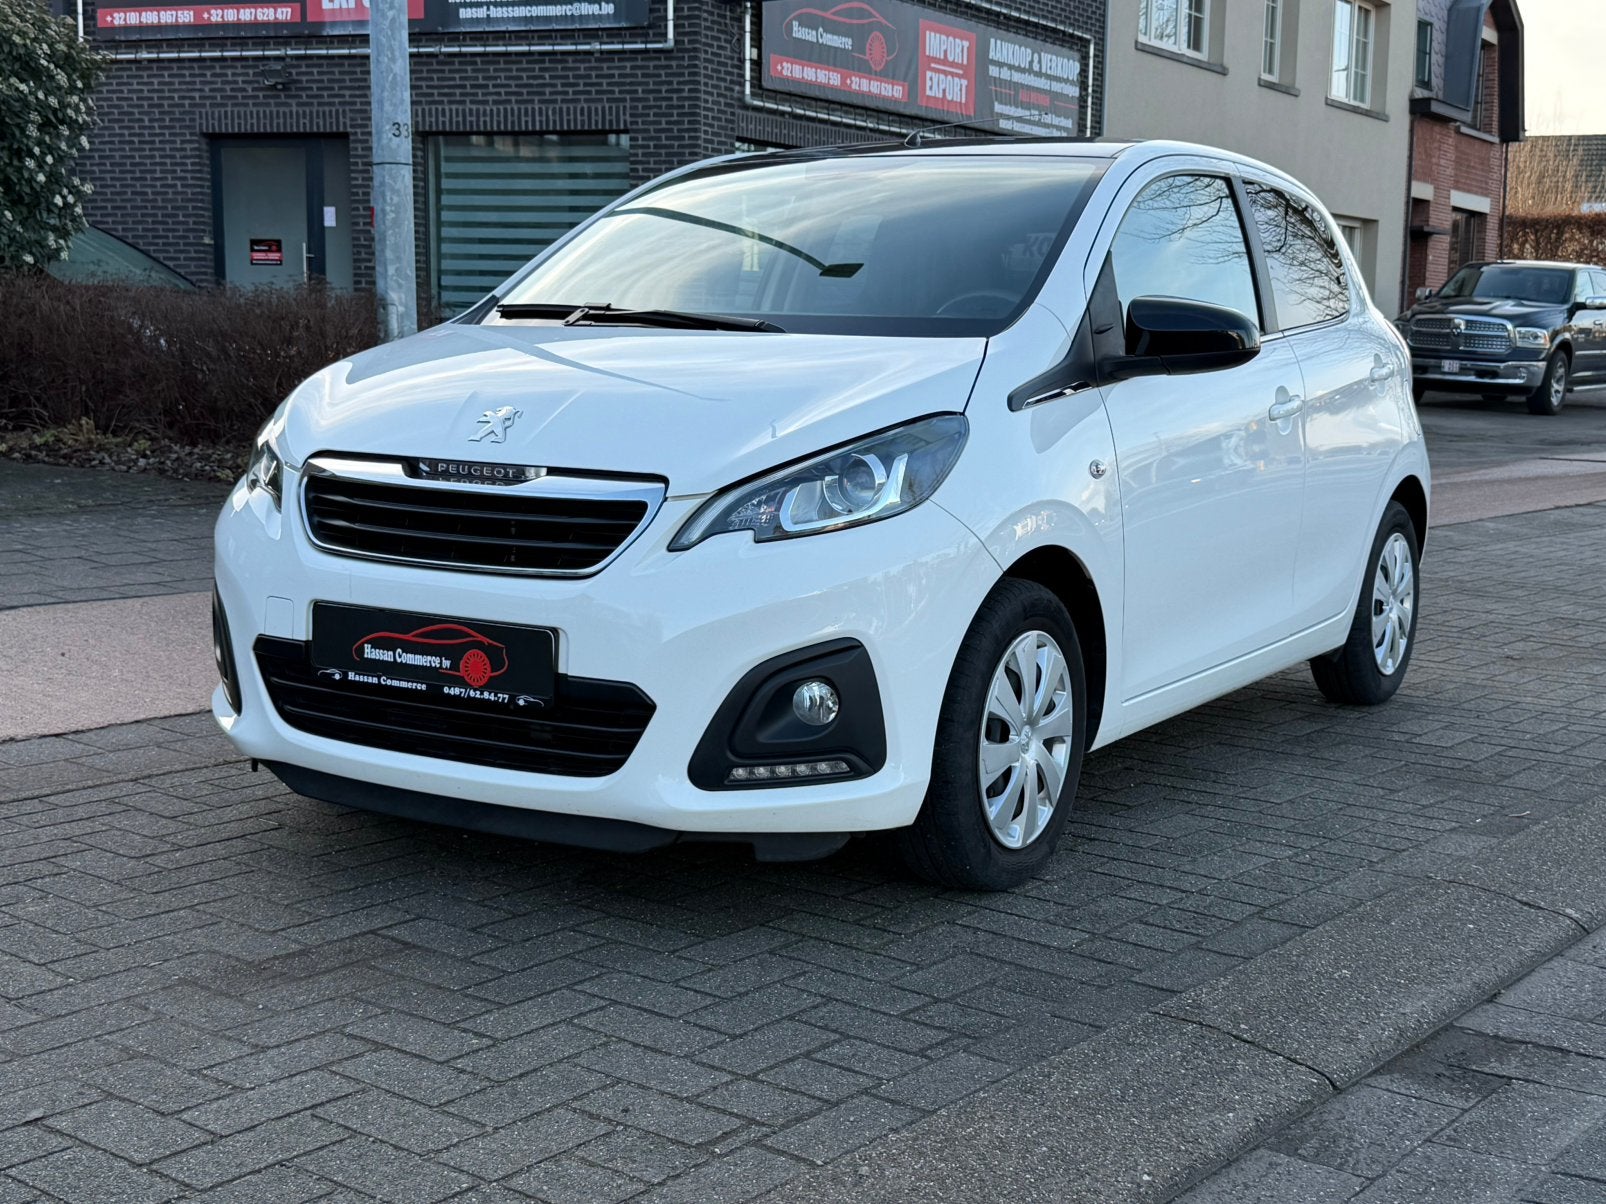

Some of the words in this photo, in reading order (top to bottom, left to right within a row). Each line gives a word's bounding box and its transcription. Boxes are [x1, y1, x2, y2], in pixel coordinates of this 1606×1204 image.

[126, 12, 140, 25] (0)
[141, 11, 159, 24] 496
[159, 11, 177, 24] 967
[177, 10, 194, 23] 551
[224, 9, 238, 22] (0)
[239, 8, 256, 21] 487
[256, 8, 275, 20] 628
[275, 7, 292, 20] 477
[792, 20, 817, 44] Hassan
[817, 26, 853, 50] Commerce
[925, 30, 969, 65] IMPORT
[988, 38, 1032, 70] AANKOOP
[1032, 52, 1040, 72] &
[1041, 52, 1080, 82] VERKOOP
[925, 71, 968, 104] EXPORT
[437, 462, 516, 478] PEUGEOT
[363, 643, 394, 663] Hassan
[395, 648, 441, 669] Commerce
[441, 657, 451, 670] bv
[348, 671, 379, 685] Hassan
[380, 675, 427, 691] Commerce
[443, 685, 509, 704] 0487/62.84.77
